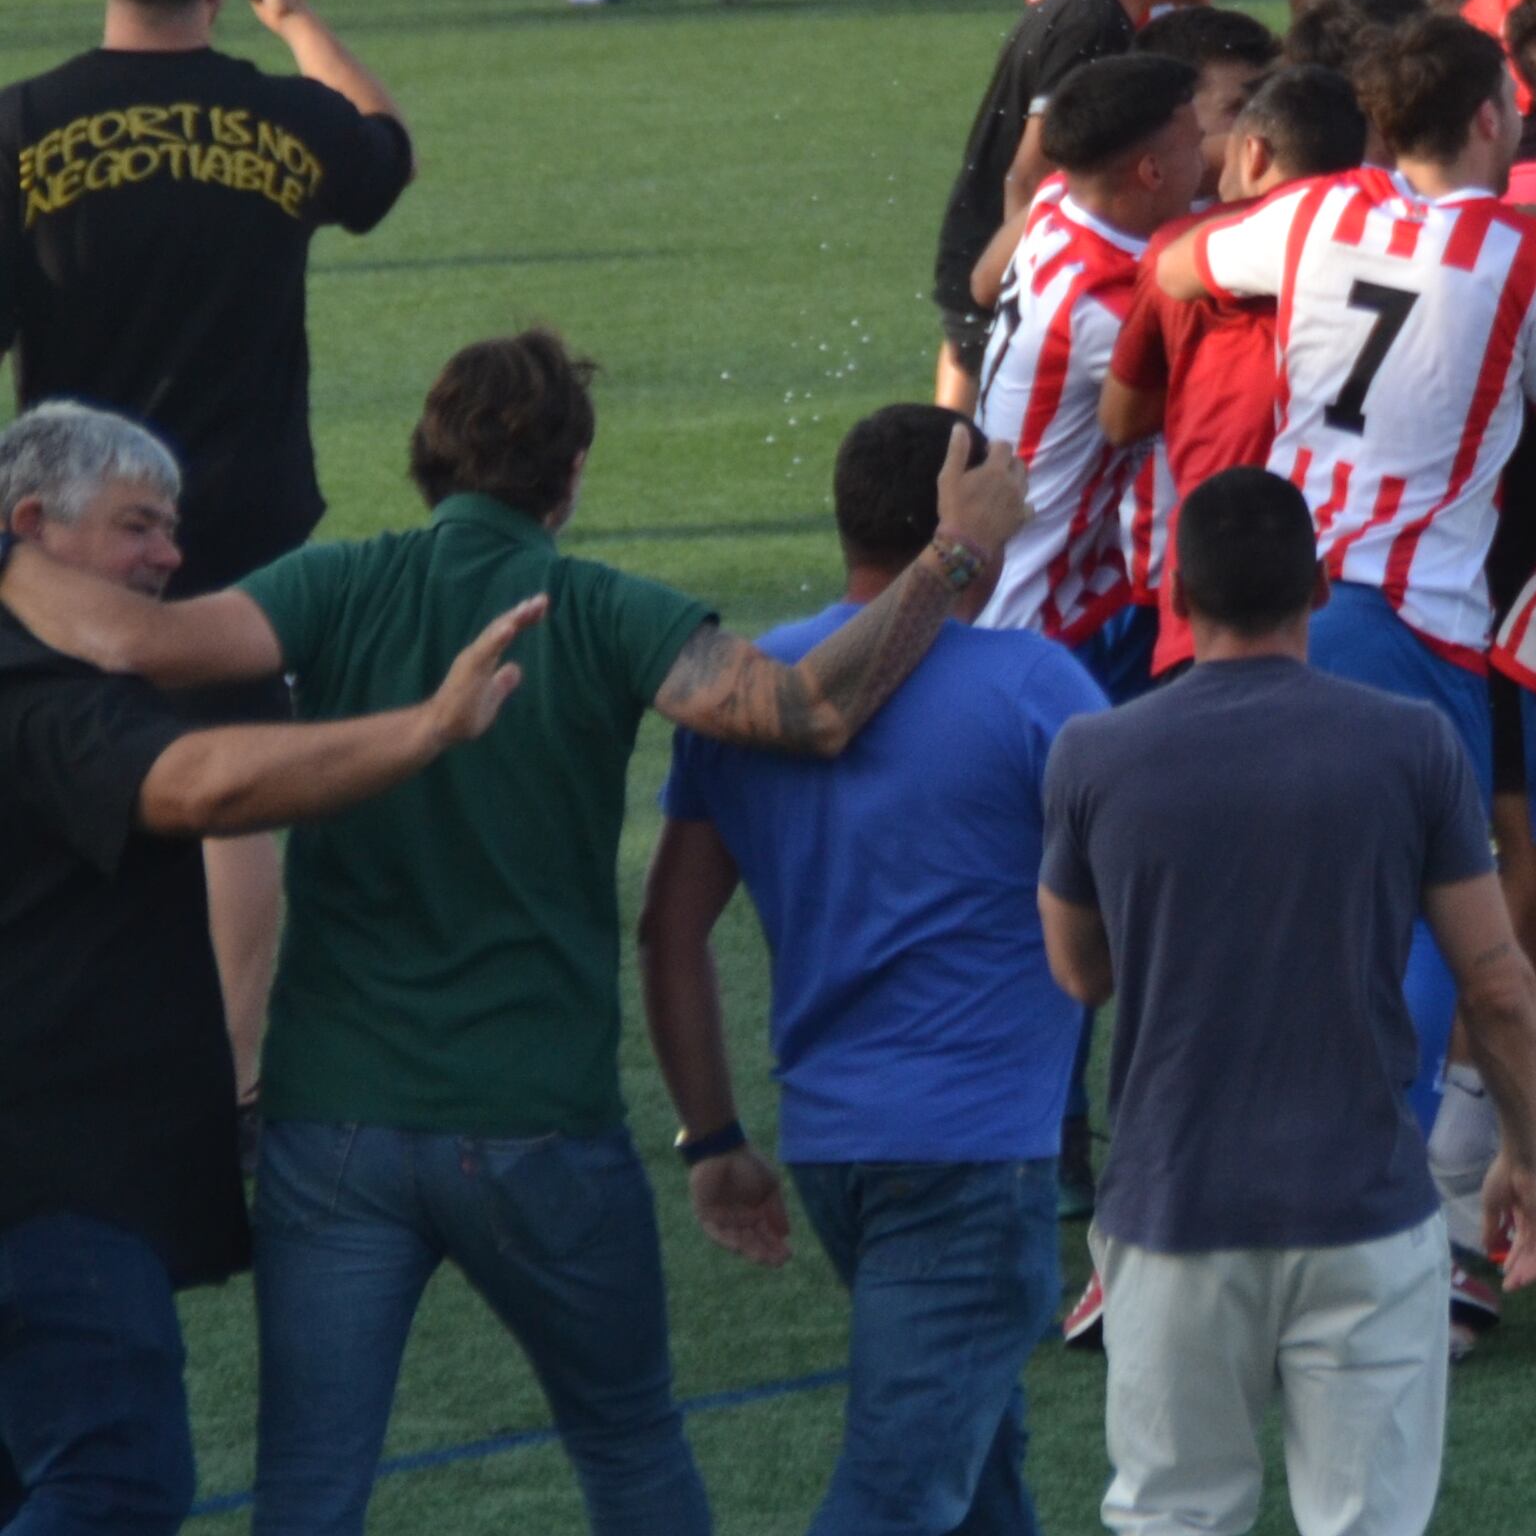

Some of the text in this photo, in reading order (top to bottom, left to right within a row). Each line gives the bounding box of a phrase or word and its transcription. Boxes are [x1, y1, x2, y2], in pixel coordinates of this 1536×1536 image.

[19, 102, 324, 198] EFFORT IS NOT
[25, 142, 306, 229] NEGOTIABLE
[1324, 280, 1420, 436] 7
